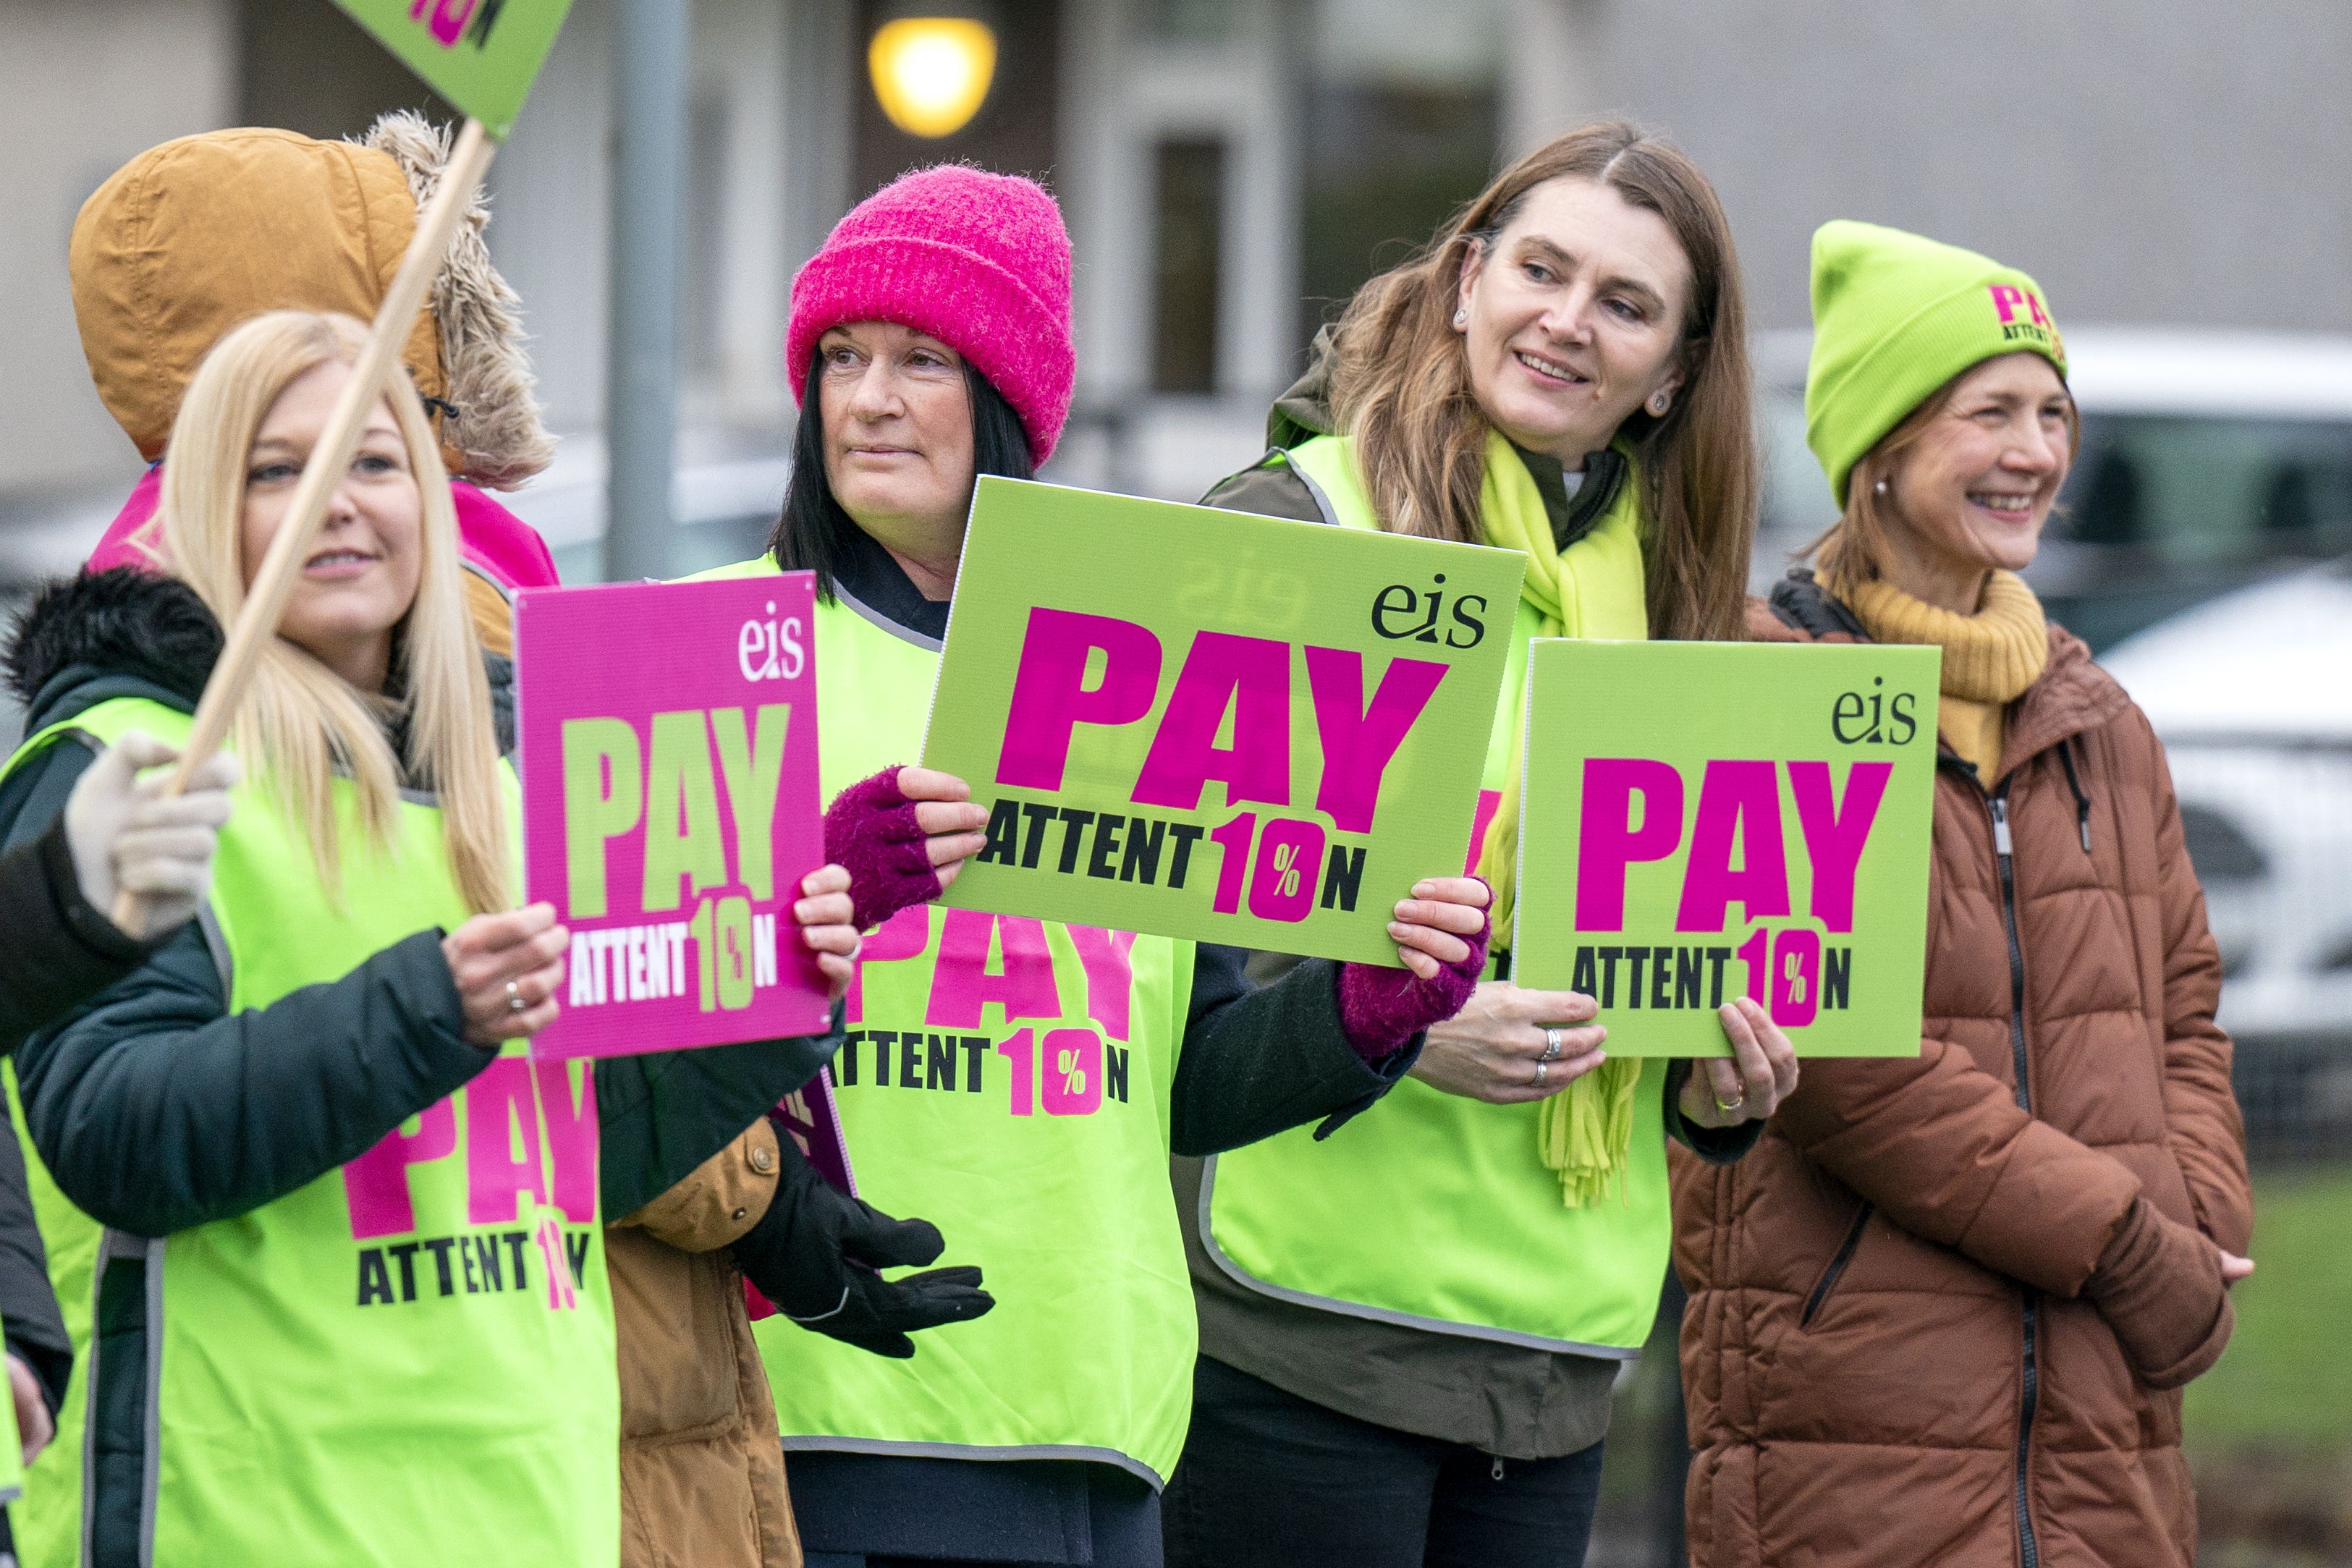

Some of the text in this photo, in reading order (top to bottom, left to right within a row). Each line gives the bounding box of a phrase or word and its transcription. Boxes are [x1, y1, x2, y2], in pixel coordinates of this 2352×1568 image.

[1988, 284, 2052, 331] PA
[739, 601, 804, 682] eis
[1371, 574, 1487, 650] eis
[995, 606, 1451, 834] PAY
[1832, 677, 1916, 745] eis
[562, 703, 792, 918] PAY
[1574, 758, 1895, 933] PAY
[832, 1027, 1129, 1116] TTENT10%N
